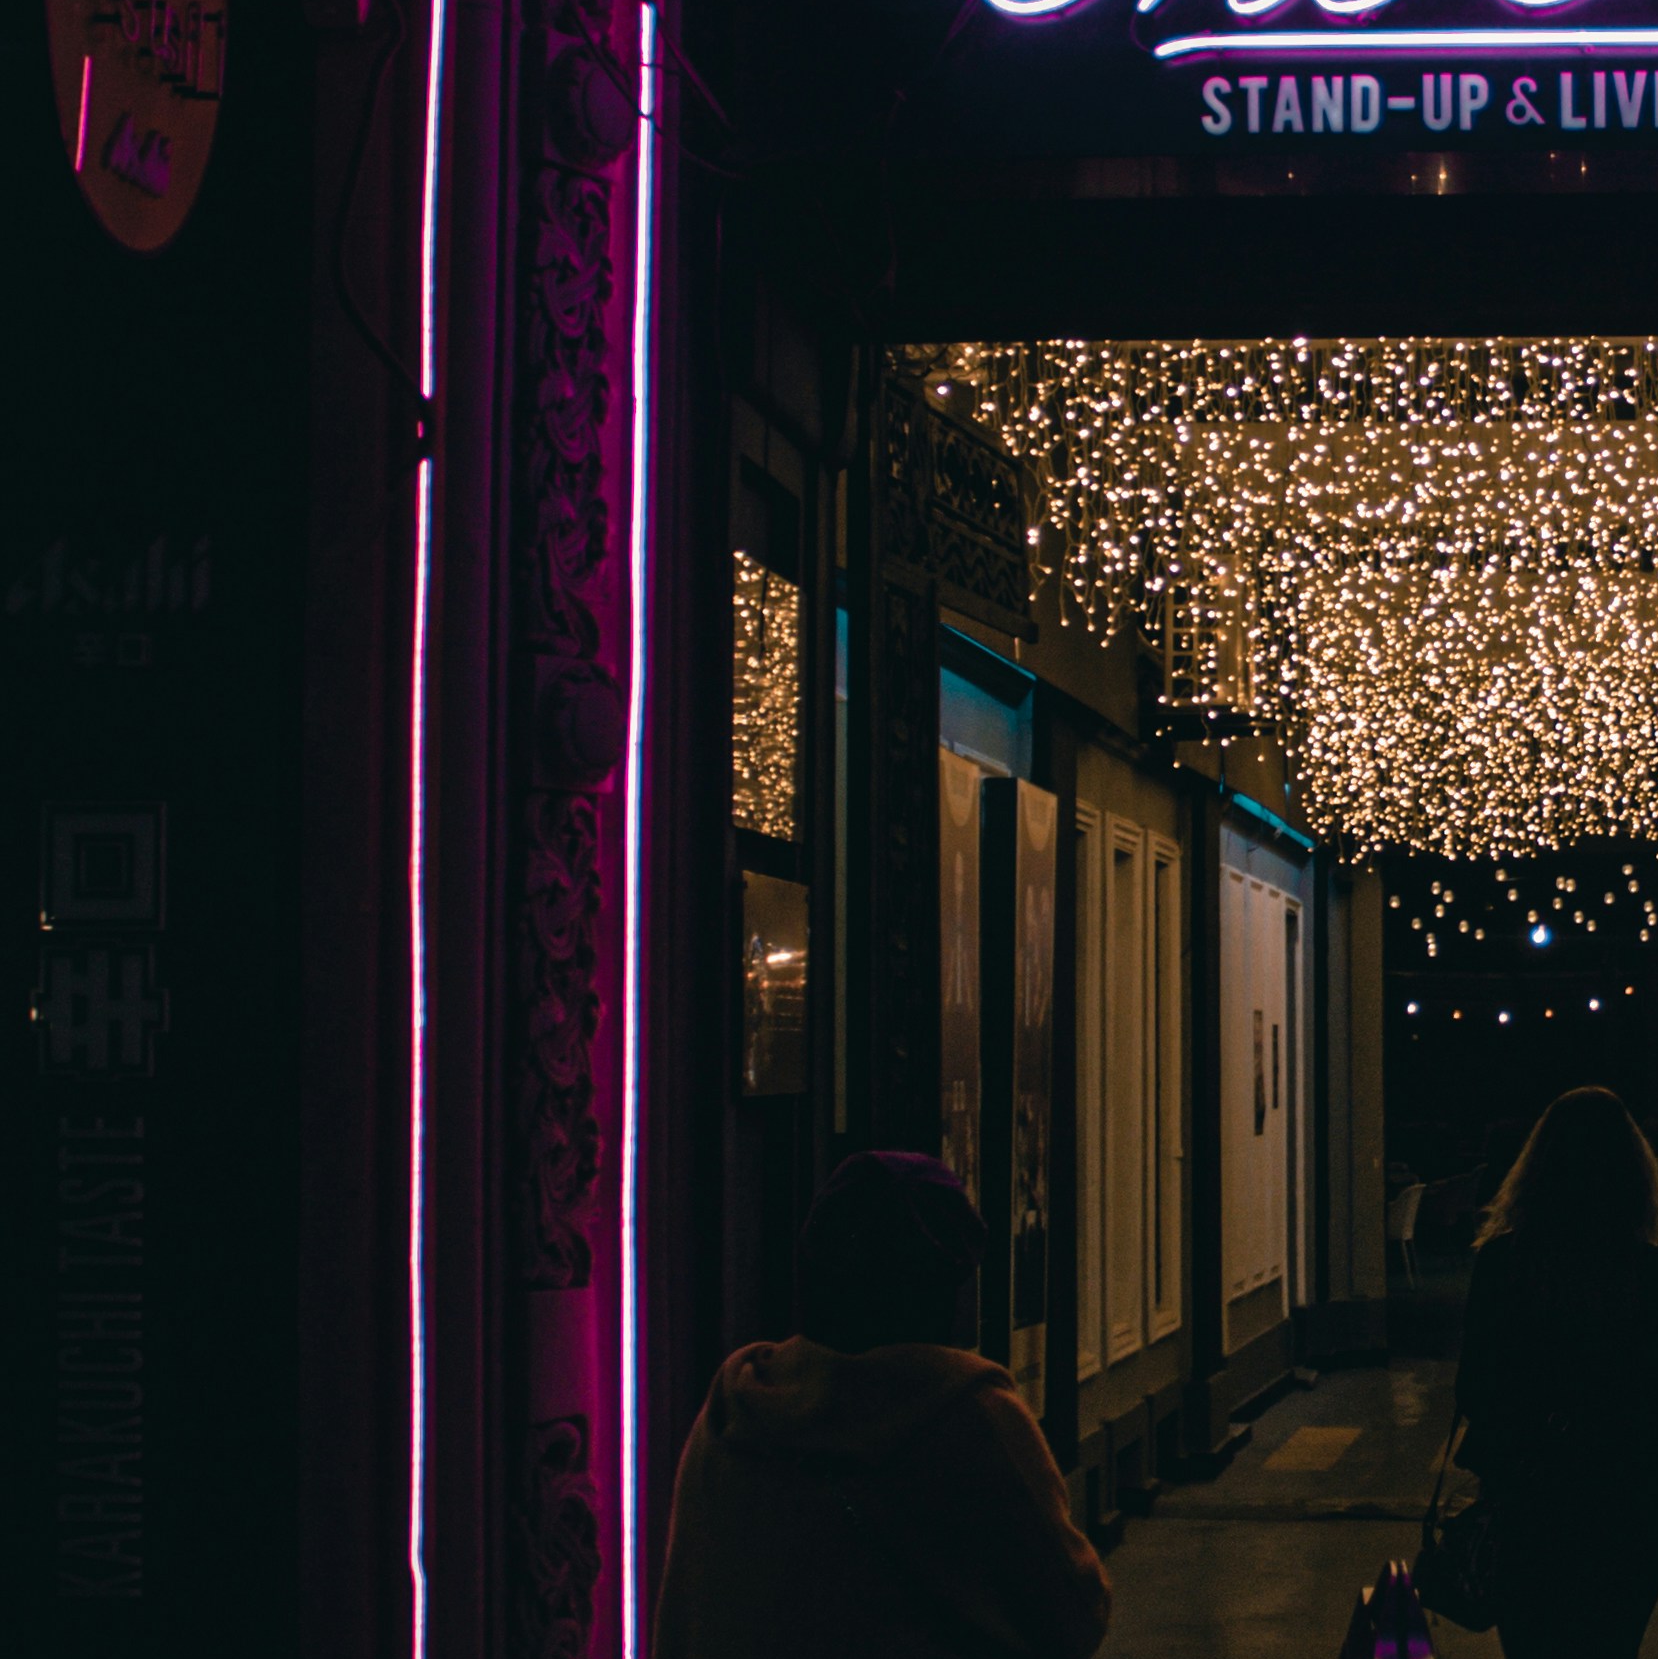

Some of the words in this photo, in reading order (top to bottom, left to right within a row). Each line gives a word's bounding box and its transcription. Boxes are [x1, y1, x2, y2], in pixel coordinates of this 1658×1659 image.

[1201, 71, 1490, 134] STAND-UP
[1504, 73, 1545, 126] &
[4, 533, 212, 615] Asahi
[57, 1114, 147, 1274] TASTE
[57, 1292, 146, 1599] KARAKUCHI
